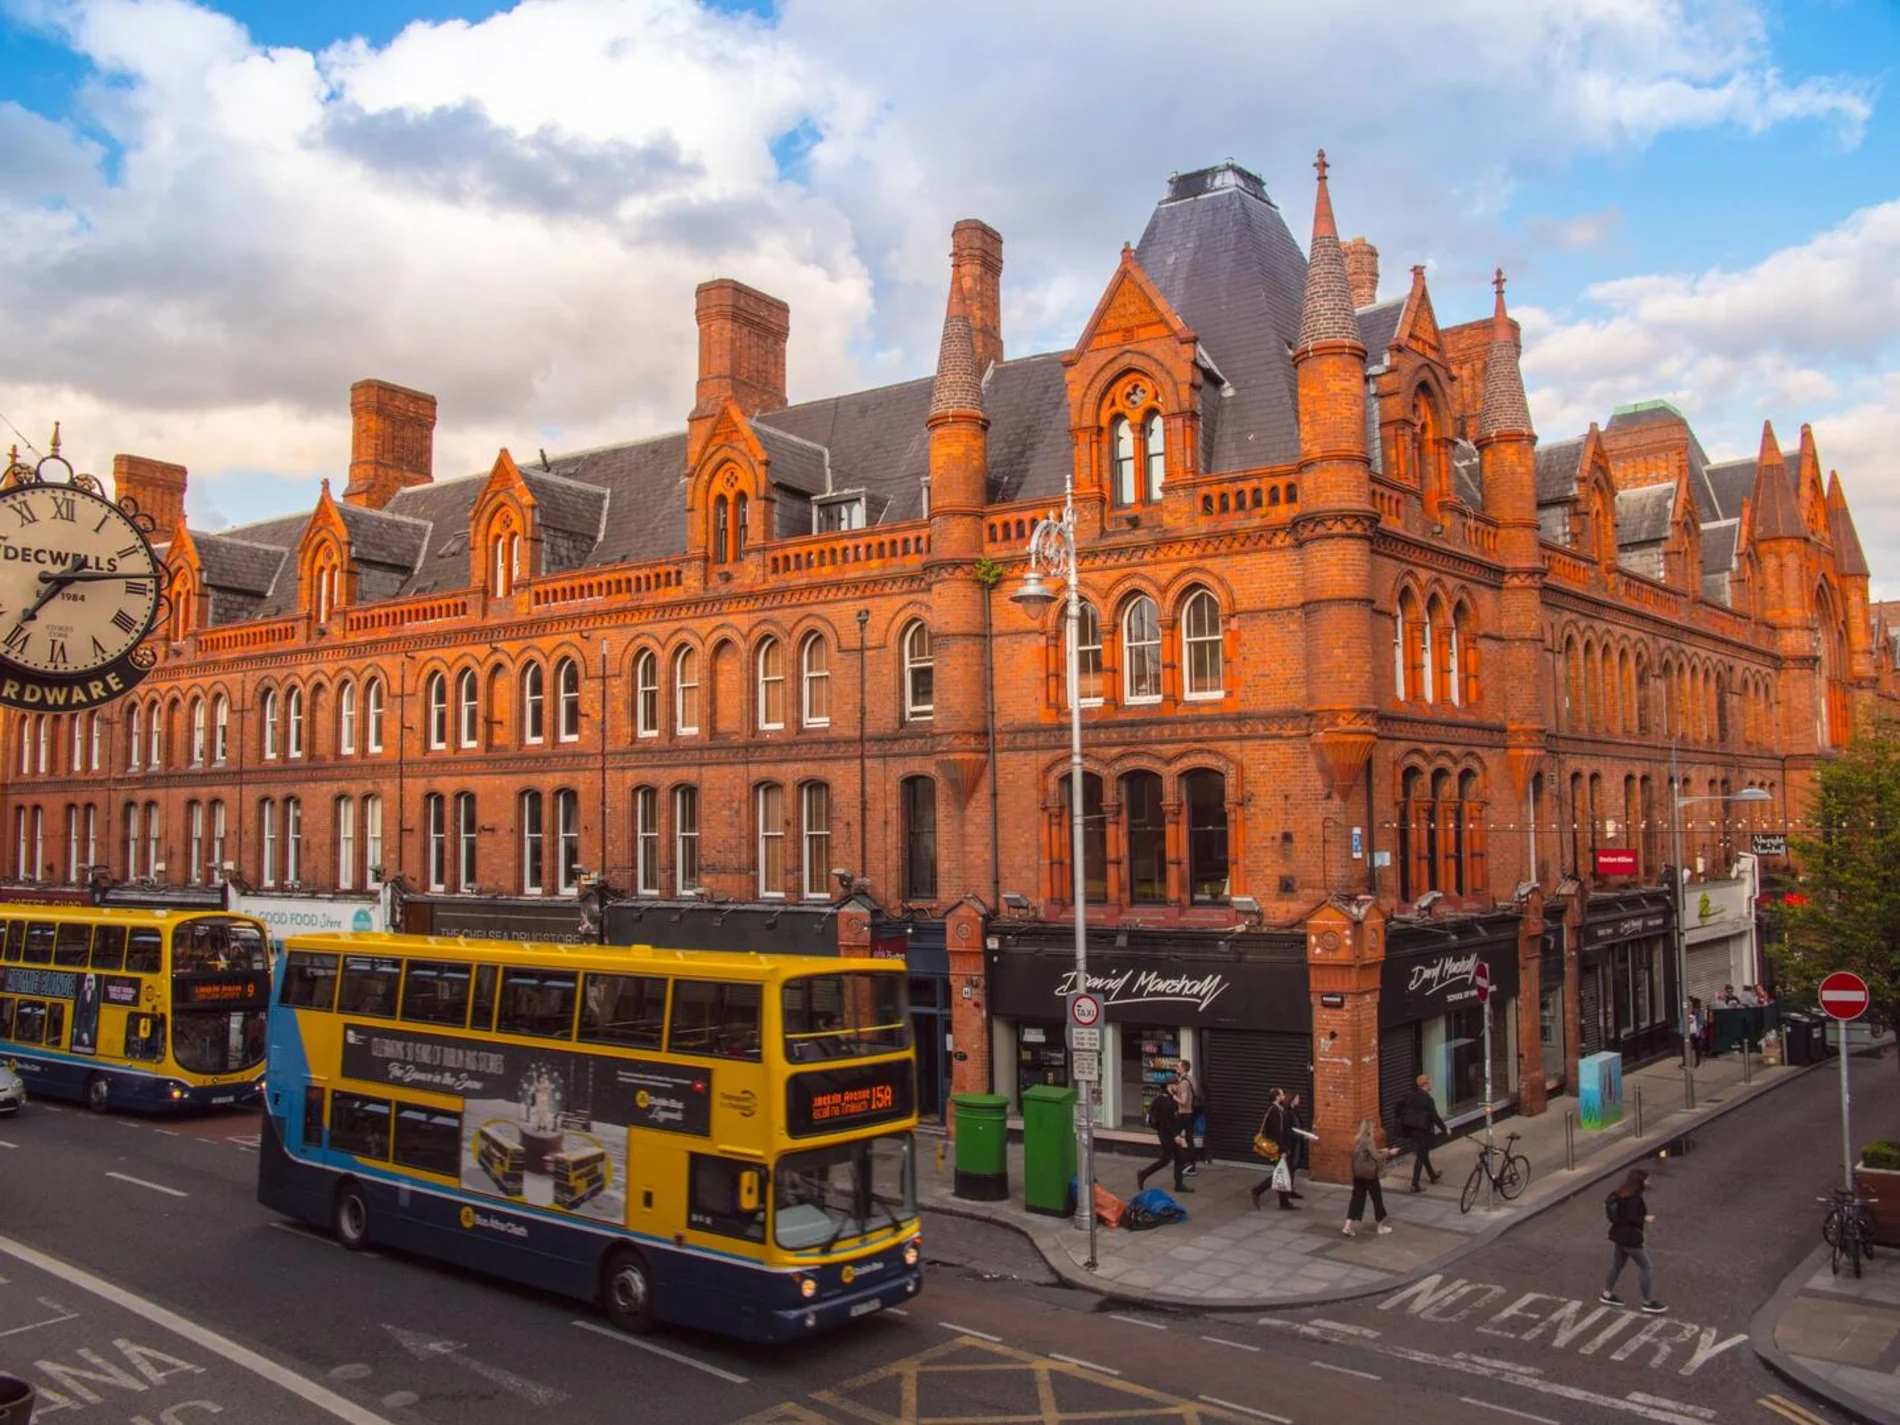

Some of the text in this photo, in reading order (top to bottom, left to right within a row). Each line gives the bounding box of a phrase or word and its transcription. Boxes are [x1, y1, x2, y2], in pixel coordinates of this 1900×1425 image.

[61, 592, 85, 602] 1984
[289, 912, 319, 926] FOOD
[1409, 958, 1442, 989] David
[247, 983, 255, 998] 9
[1054, 968, 1230, 1012] David Marshall
[1077, 1008, 1095, 1017] TAXI
[871, 1084, 892, 1110] 15A
[1377, 1273, 1748, 1376] NO ENTRY
